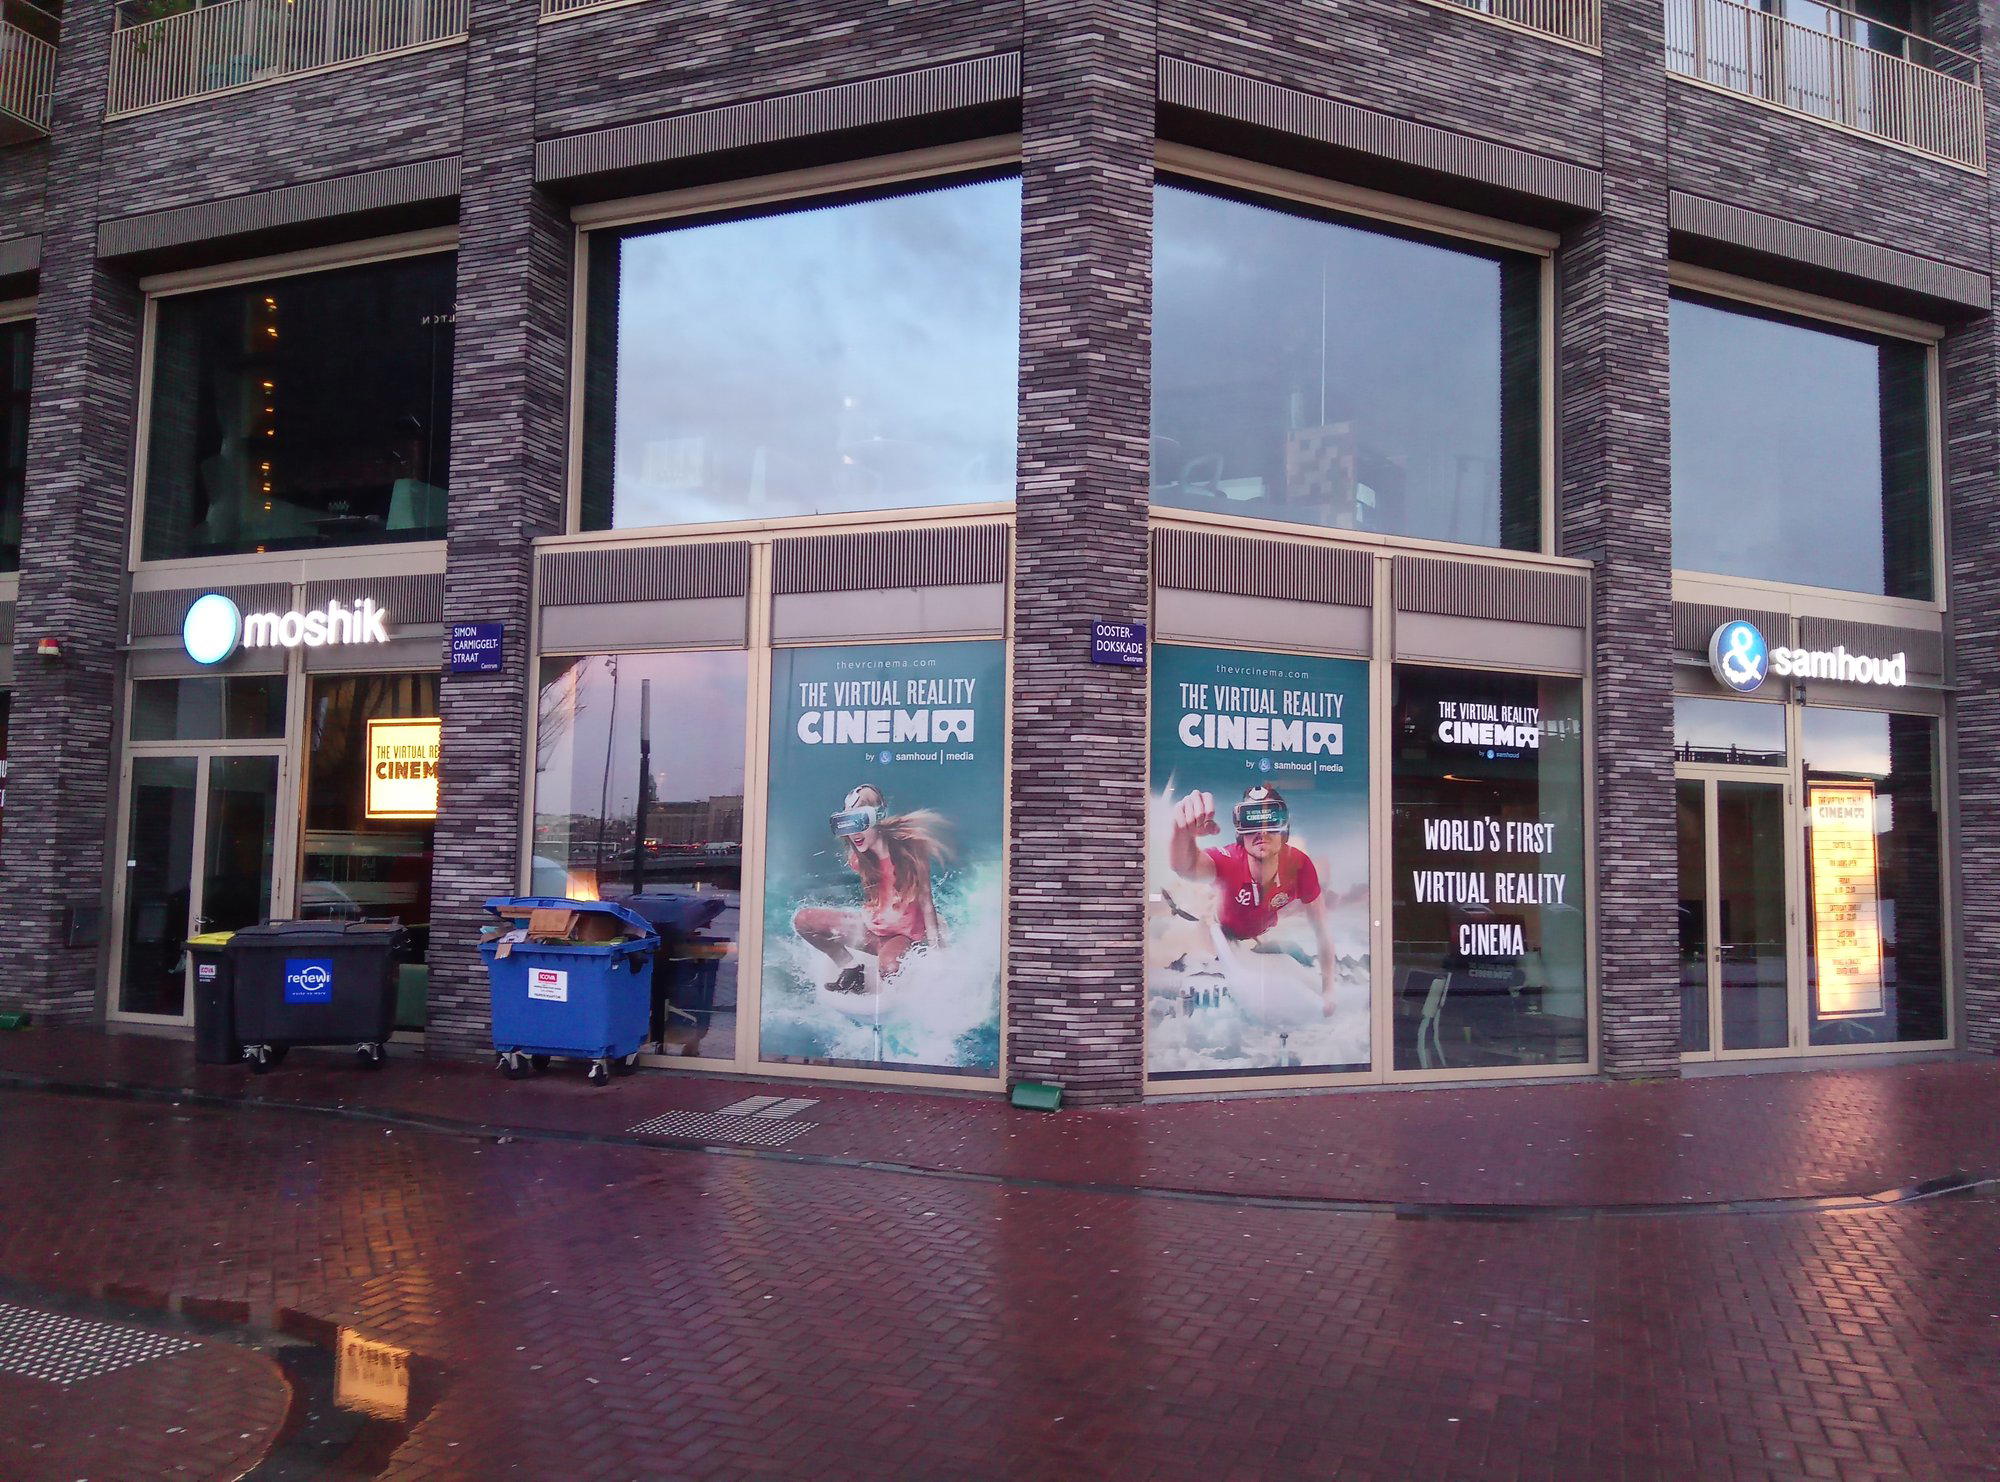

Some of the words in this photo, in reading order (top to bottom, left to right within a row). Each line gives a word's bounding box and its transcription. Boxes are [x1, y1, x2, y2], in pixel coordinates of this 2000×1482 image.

[243, 598, 390, 648] moshik
[454, 627, 477, 637] SIMON
[1096, 625, 1133, 638] OOSTER-
[453, 639, 499, 650] CARMIGGELT-
[1096, 640, 1143, 654] DOKSKADE
[453, 653, 479, 663] STRAAT
[1771, 645, 1906, 686] samhoud
[1216, 664, 1309, 679] thevrcinema.com
[799, 682, 828, 707] THE
[834, 680, 901, 707] VIRTUAL
[907, 678, 976, 705] REALITY
[1179, 683, 1209, 710] THE
[1214, 685, 1278, 714] VIRTUAL
[1283, 690, 1344, 718] REALITY
[1439, 701, 1457, 719] THE
[1459, 703, 1499, 721] VIRTUAL
[1501, 706, 1539, 724] REALITY
[376, 745, 391, 759] THE
[393, 745, 427, 759] VIRTUAL
[865, 752, 875, 762] by
[895, 752, 938, 761] samhoud
[946, 752, 974, 761] media
[375, 761, 439, 779] CINEM
[1245, 759, 1255, 768] by
[1273, 761, 1312, 771] samhoud
[1319, 763, 1344, 773] media
[1423, 816, 1500, 852] WORLD'S
[1506, 821, 1555, 853] FIRST
[1413, 871, 1490, 903] VIRTUAL
[1495, 872, 1566, 904] REALITY
[1459, 924, 1525, 955] CINEMA
[287, 971, 331, 983] renewi
